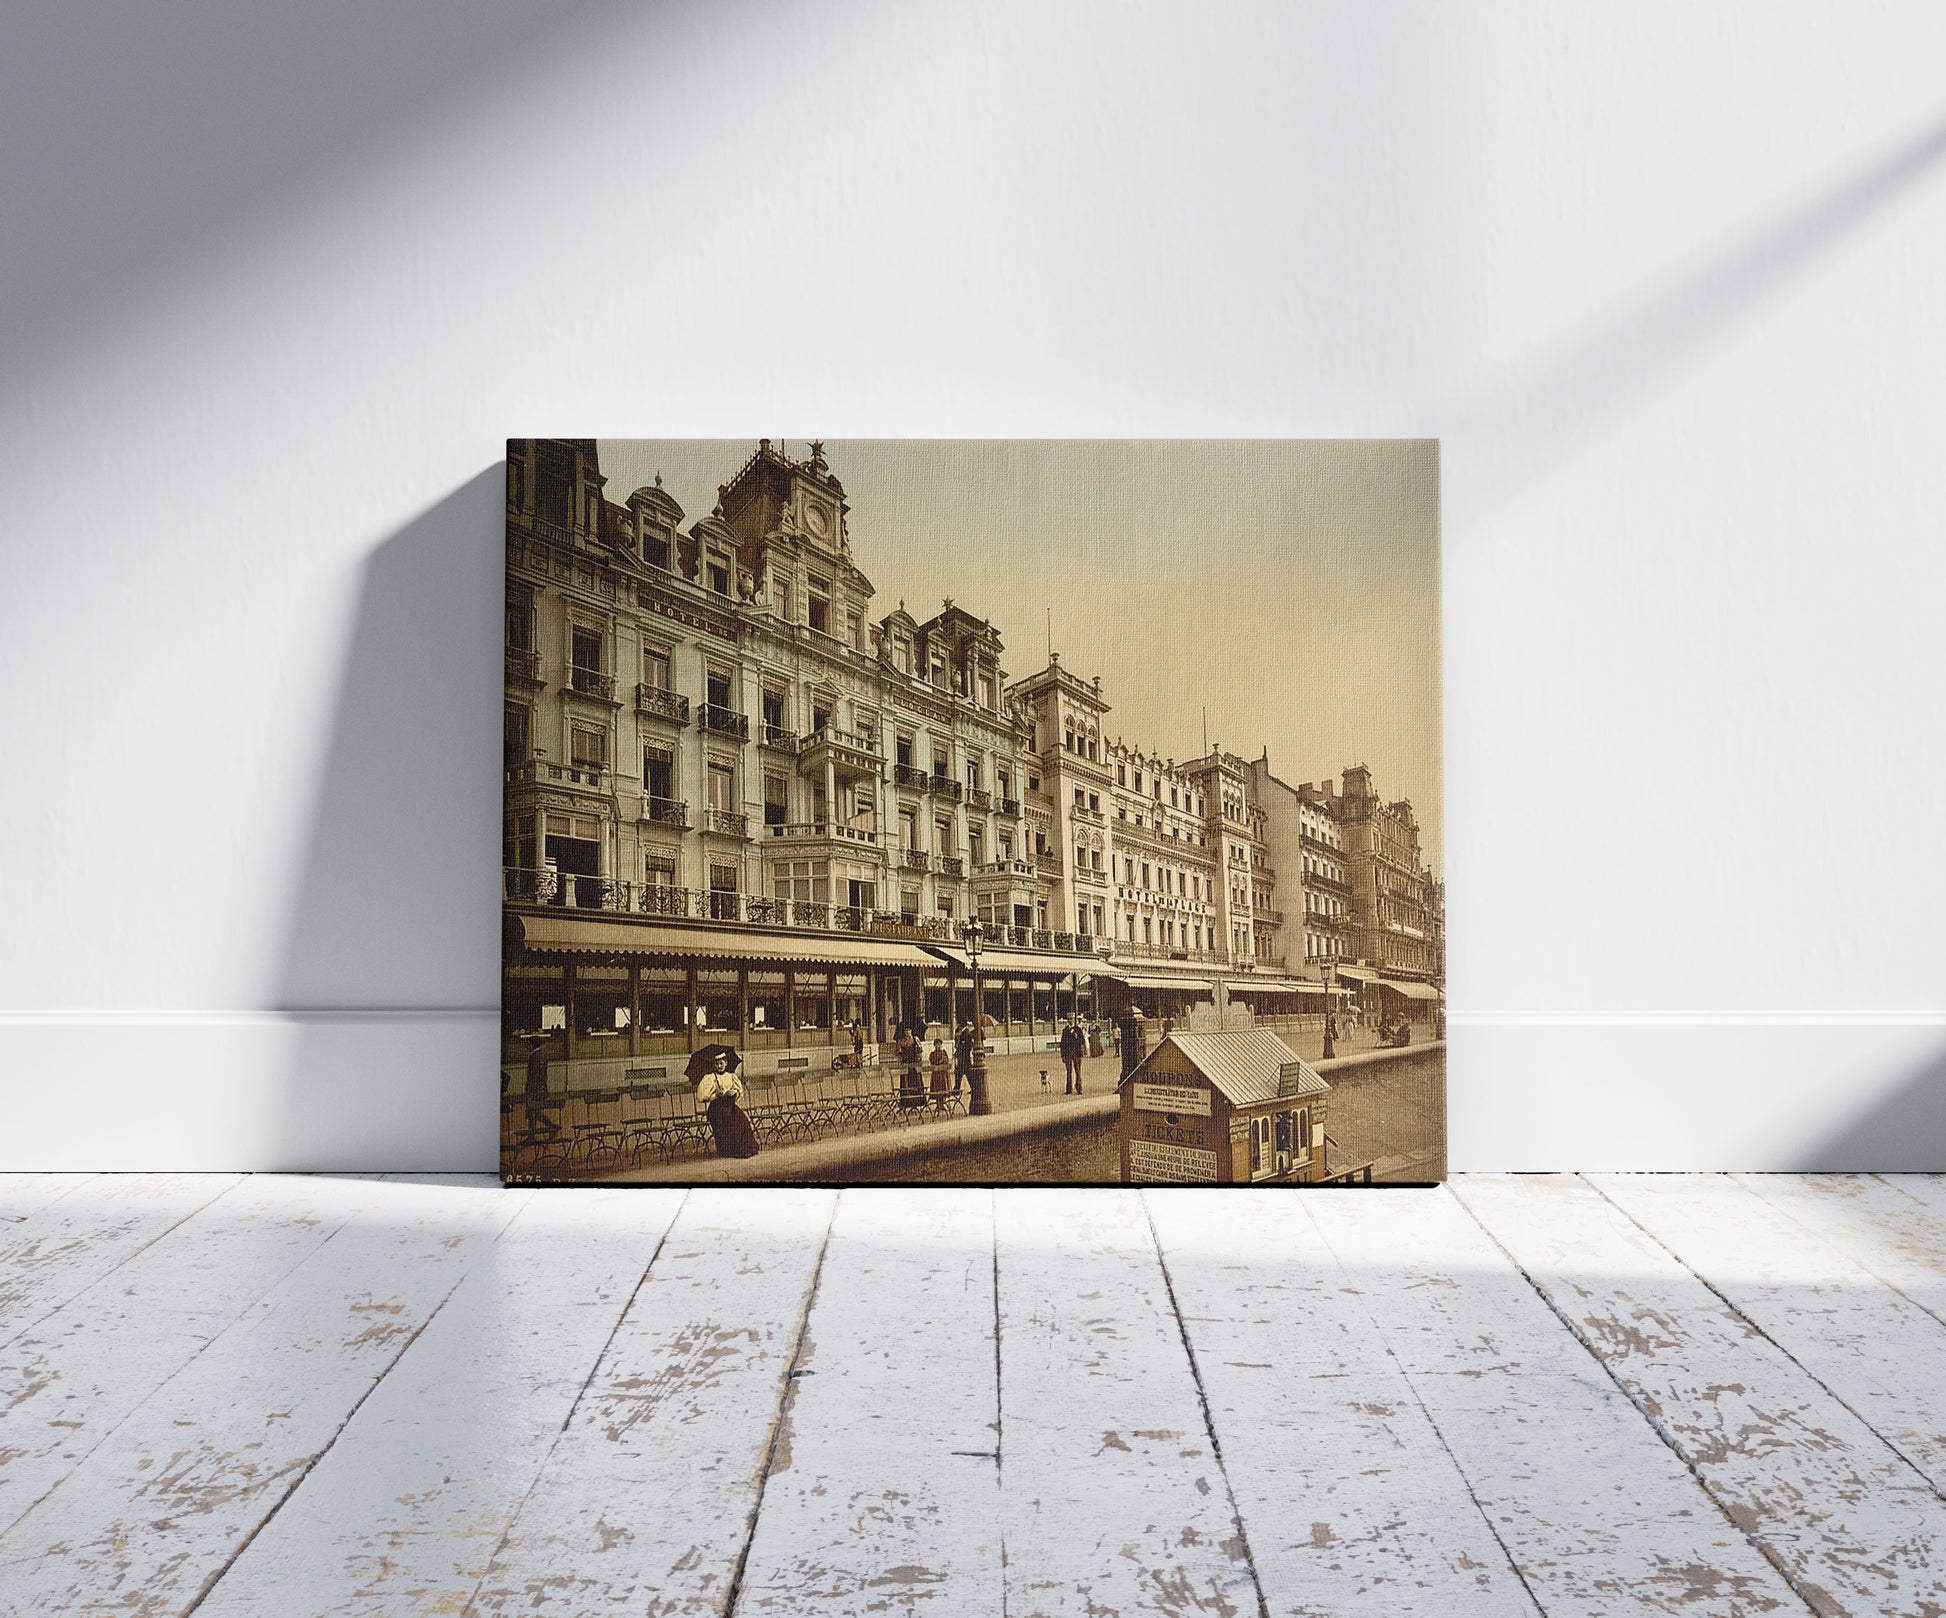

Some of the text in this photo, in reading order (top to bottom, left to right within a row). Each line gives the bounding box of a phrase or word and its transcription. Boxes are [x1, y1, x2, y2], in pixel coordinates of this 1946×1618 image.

[653, 602, 711, 632] HOTEL
[1118, 887, 1157, 904] HOTEL
[1173, 898, 1206, 914] PLAGE
[873, 922, 928, 938] RESTAURANT
[1145, 1124, 1204, 1146] TICKETS
